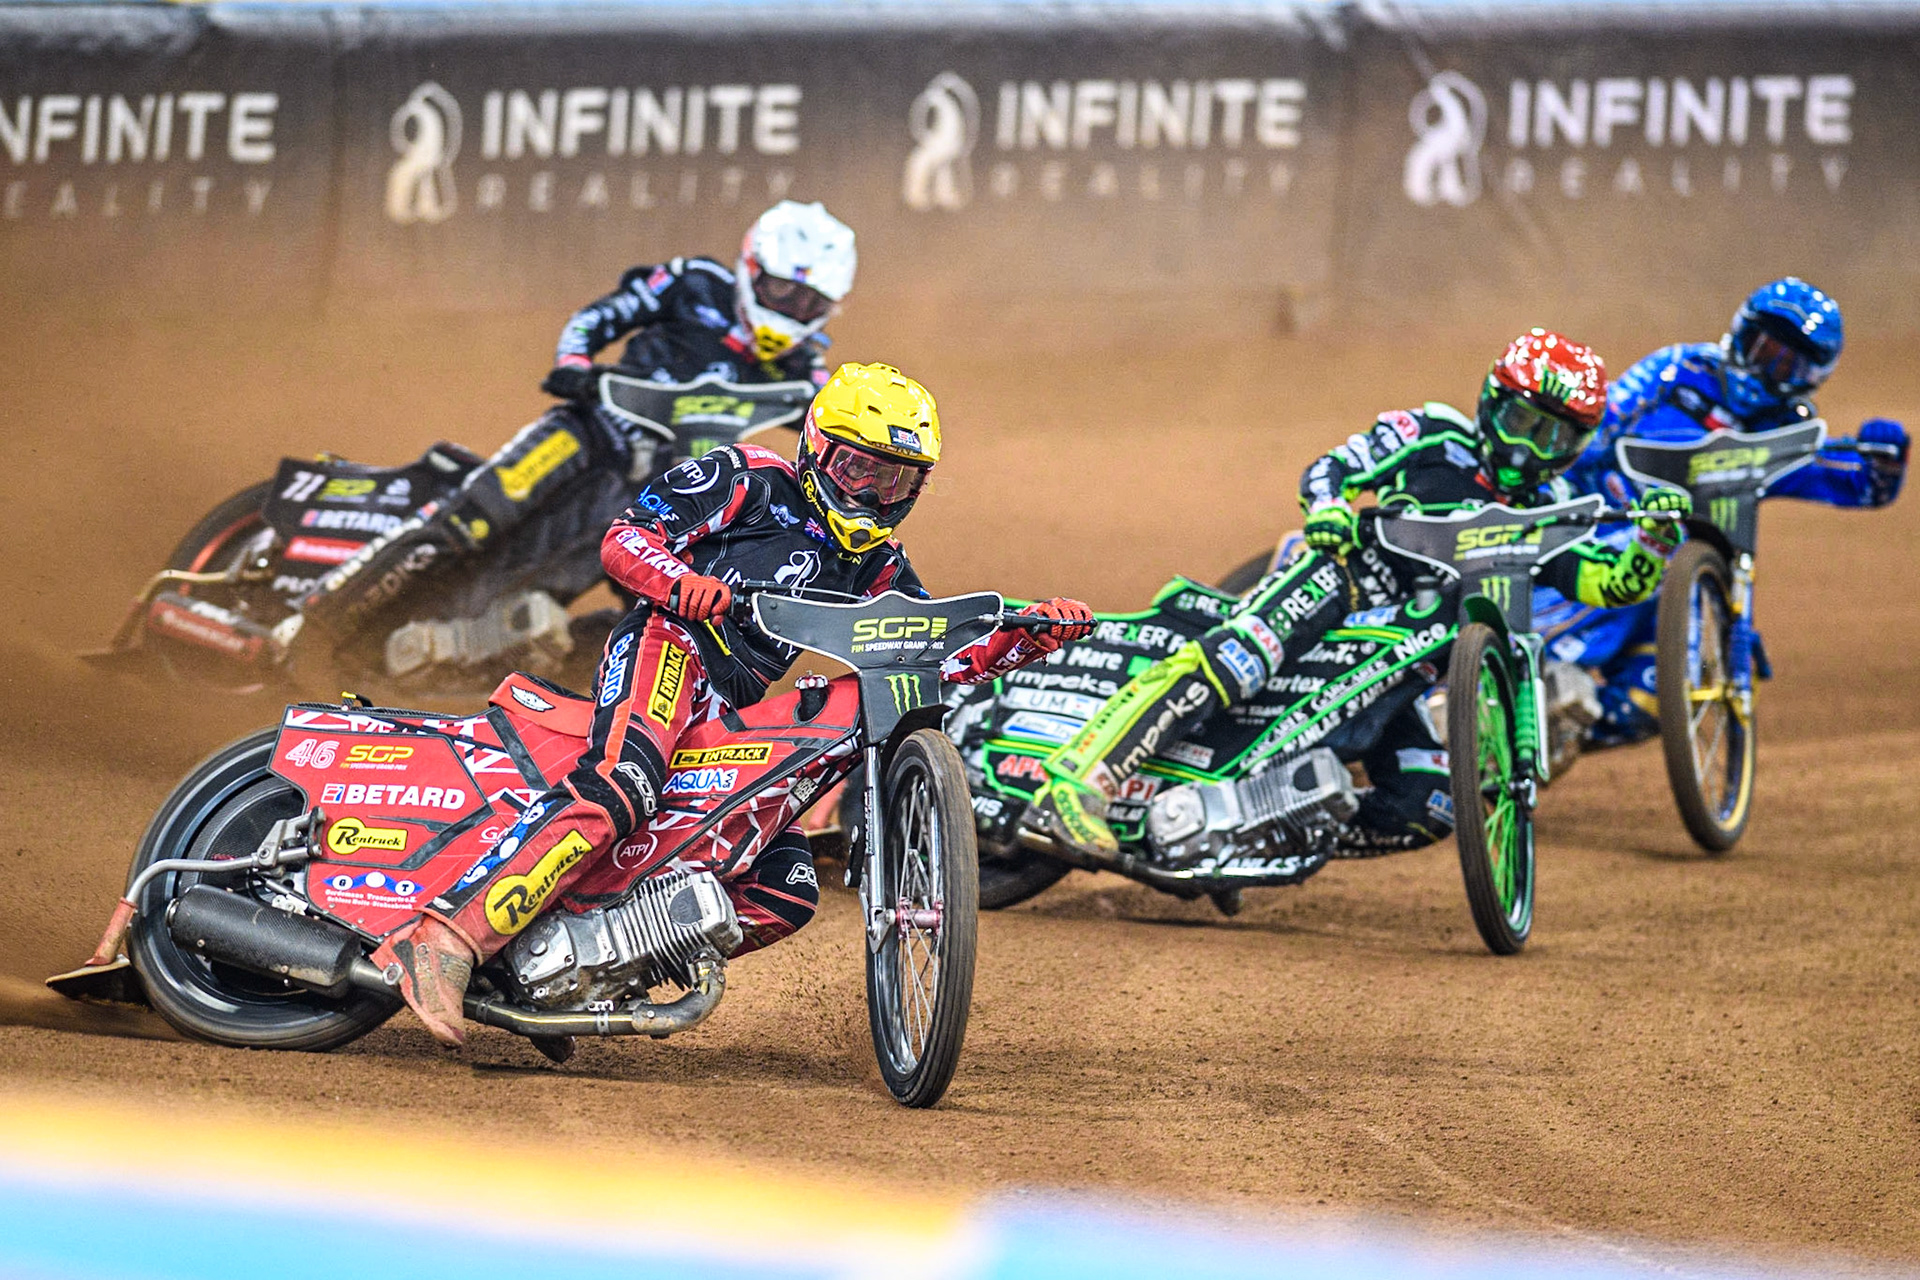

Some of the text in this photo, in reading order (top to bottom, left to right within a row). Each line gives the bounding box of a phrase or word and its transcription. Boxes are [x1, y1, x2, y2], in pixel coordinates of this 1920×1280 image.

[482, 85, 801, 160] INFINITE
[997, 78, 1306, 150] INFINITE
[1508, 75, 1856, 149] INFINITE
[620, 531, 690, 578] BETARD
[852, 616, 930, 642] SGP
[865, 640, 904, 652] SPEEDWAY
[285, 739, 414, 769] 46 SGP
[702, 748, 764, 764] ENTRACK
[664, 772, 721, 791] AQUA
[345, 784, 465, 810] BETARD
[336, 826, 401, 846] Rentruck
[621, 843, 650, 857] ATPI
[494, 845, 585, 927] Rentruck
